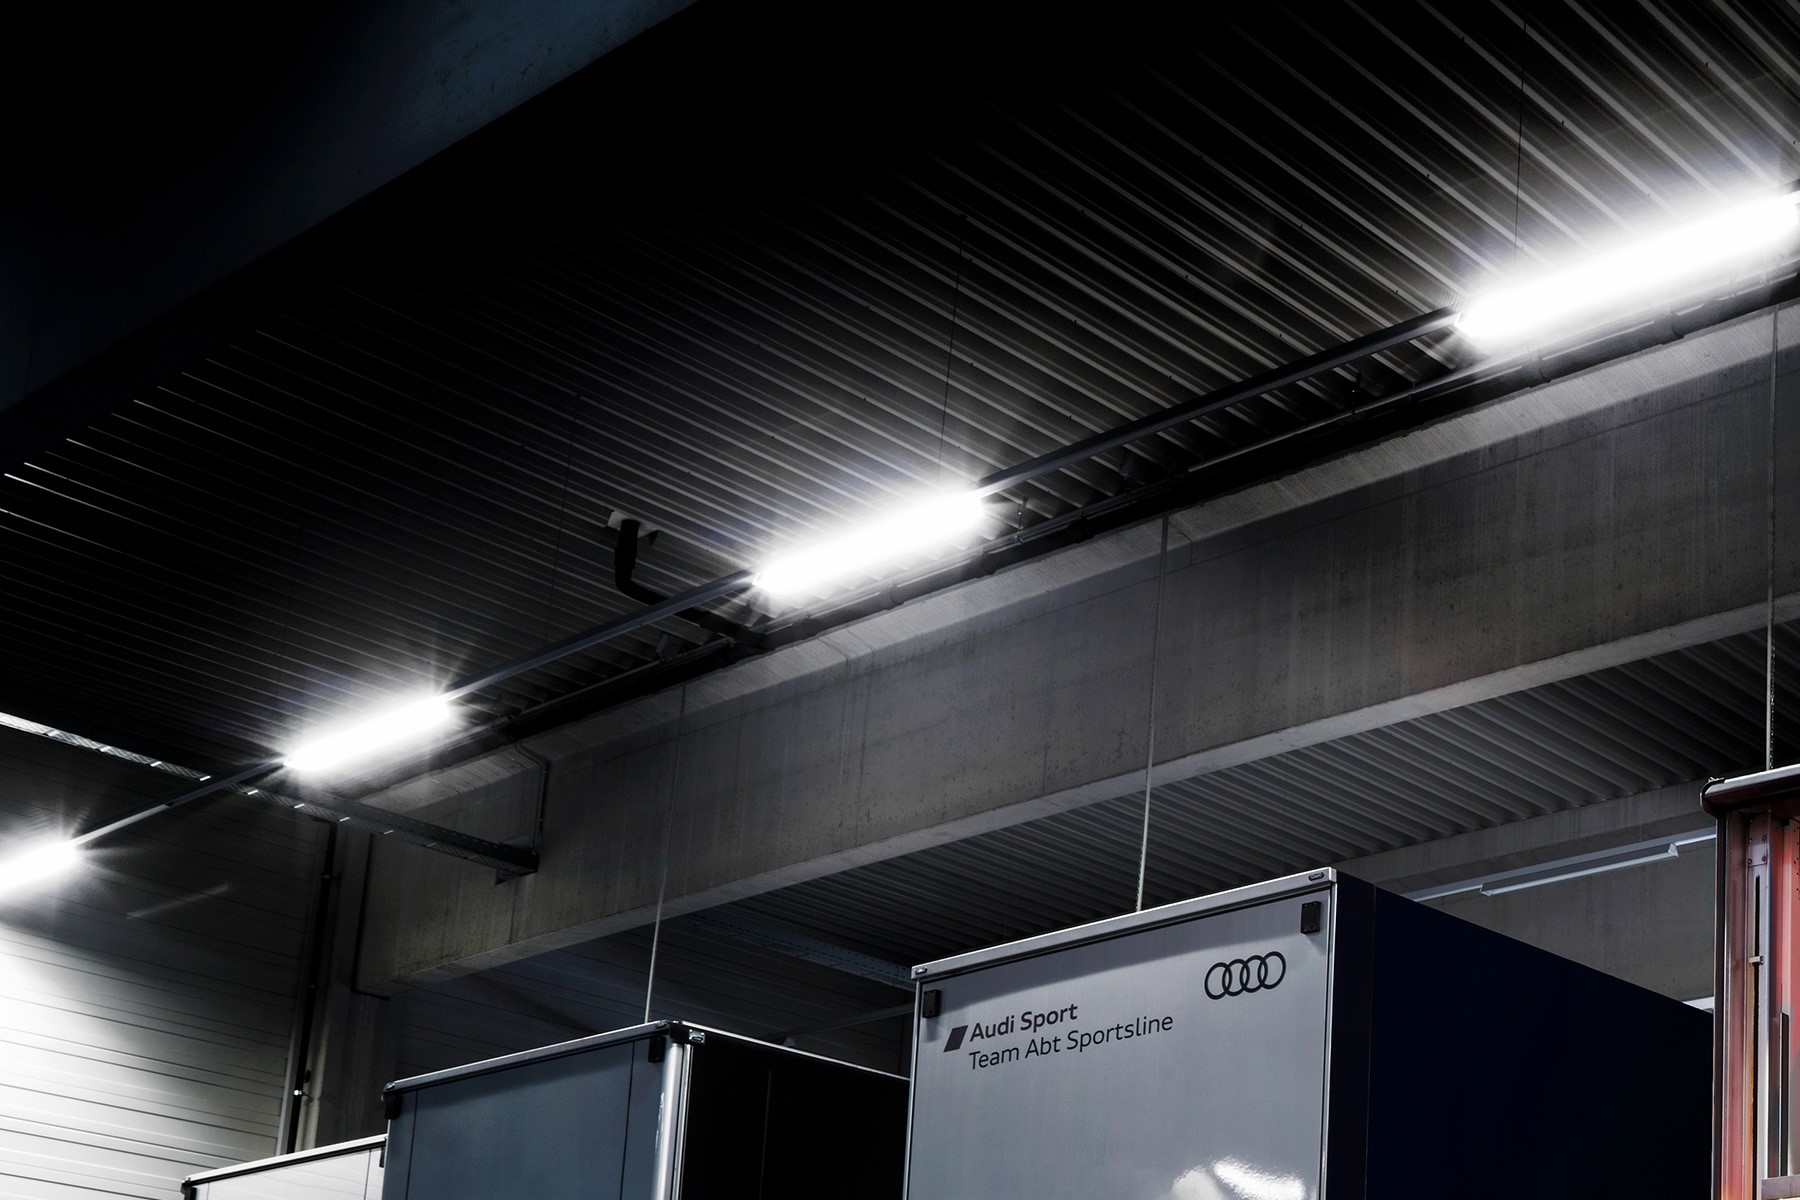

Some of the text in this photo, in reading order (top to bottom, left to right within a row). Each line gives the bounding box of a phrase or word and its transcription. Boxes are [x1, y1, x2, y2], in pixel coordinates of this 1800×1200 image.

[969, 1003, 1078, 1042] Audi Sport
[969, 1013, 1174, 1071] Team Abt Sportsline
